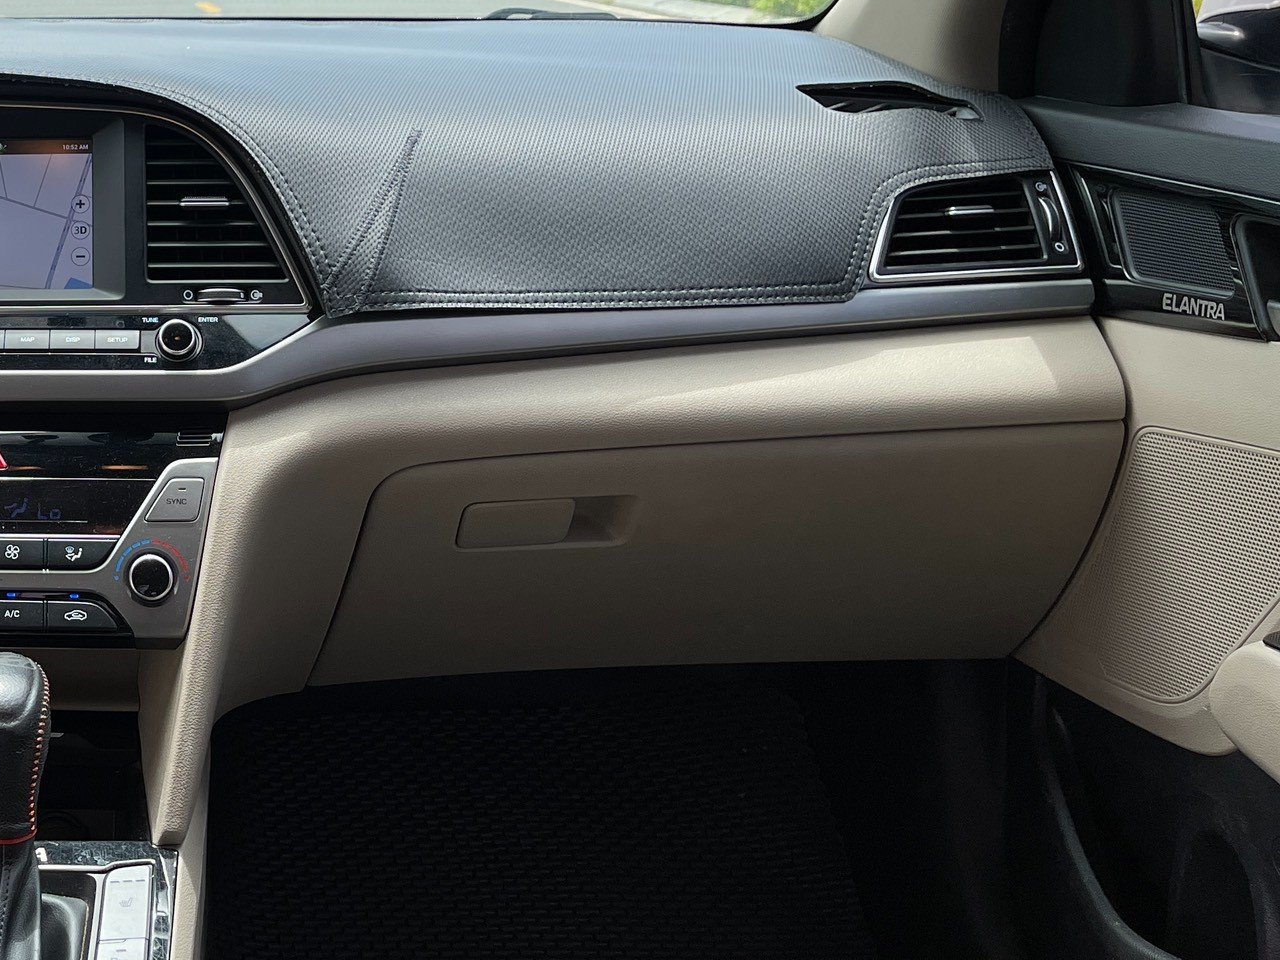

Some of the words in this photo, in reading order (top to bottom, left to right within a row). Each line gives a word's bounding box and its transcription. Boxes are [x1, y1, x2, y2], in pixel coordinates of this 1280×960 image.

[74, 226, 87, 235] 3D
[1162, 292, 1225, 321] ELANTRA
[448, 472, 583, 495] AIRBAG
[4, 609, 20, 618] A/C
